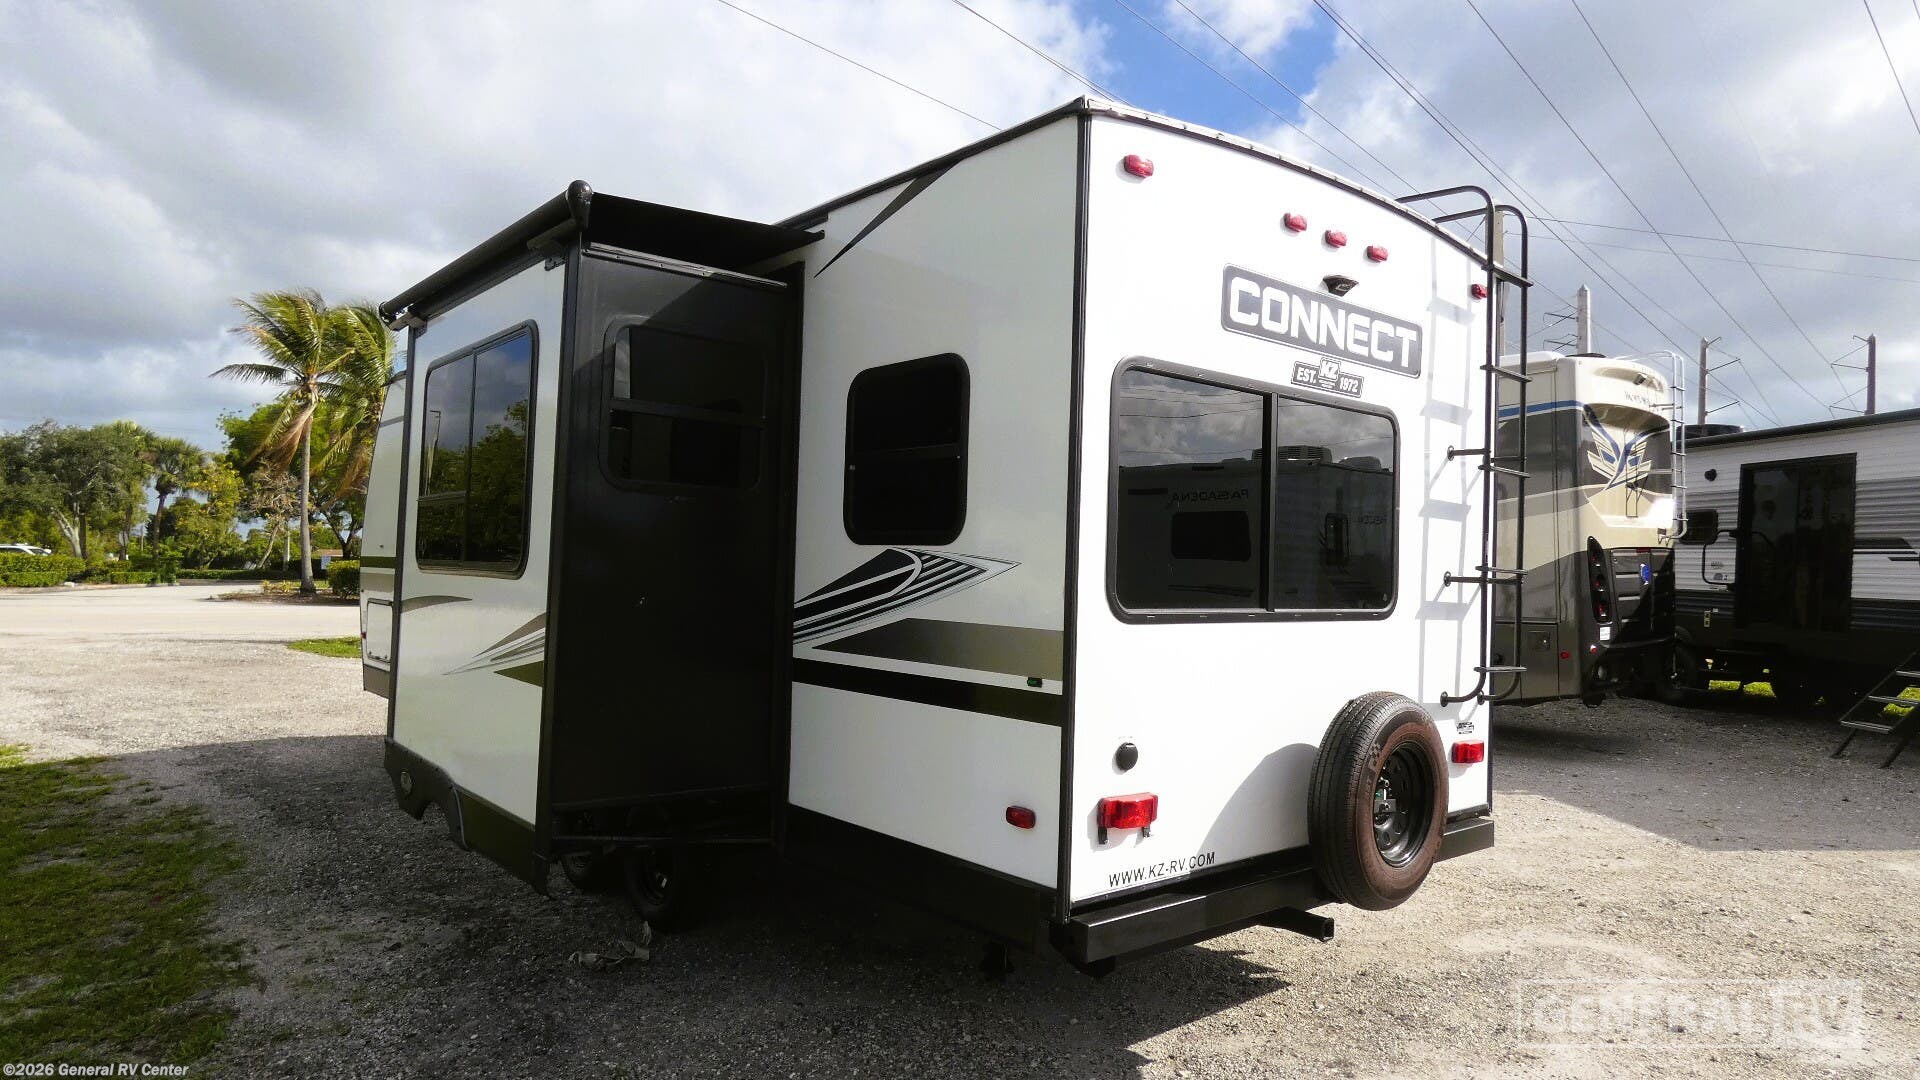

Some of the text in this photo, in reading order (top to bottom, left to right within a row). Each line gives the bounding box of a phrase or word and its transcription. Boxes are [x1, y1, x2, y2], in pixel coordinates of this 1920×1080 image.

[1229, 276, 1417, 368] CONNECT
[1296, 367, 1317, 384] EST.
[1340, 377, 1359, 393] 1972
[1320, 359, 1339, 380] KZ
[1108, 851, 1216, 887] WWW.KZ-RV.COM
